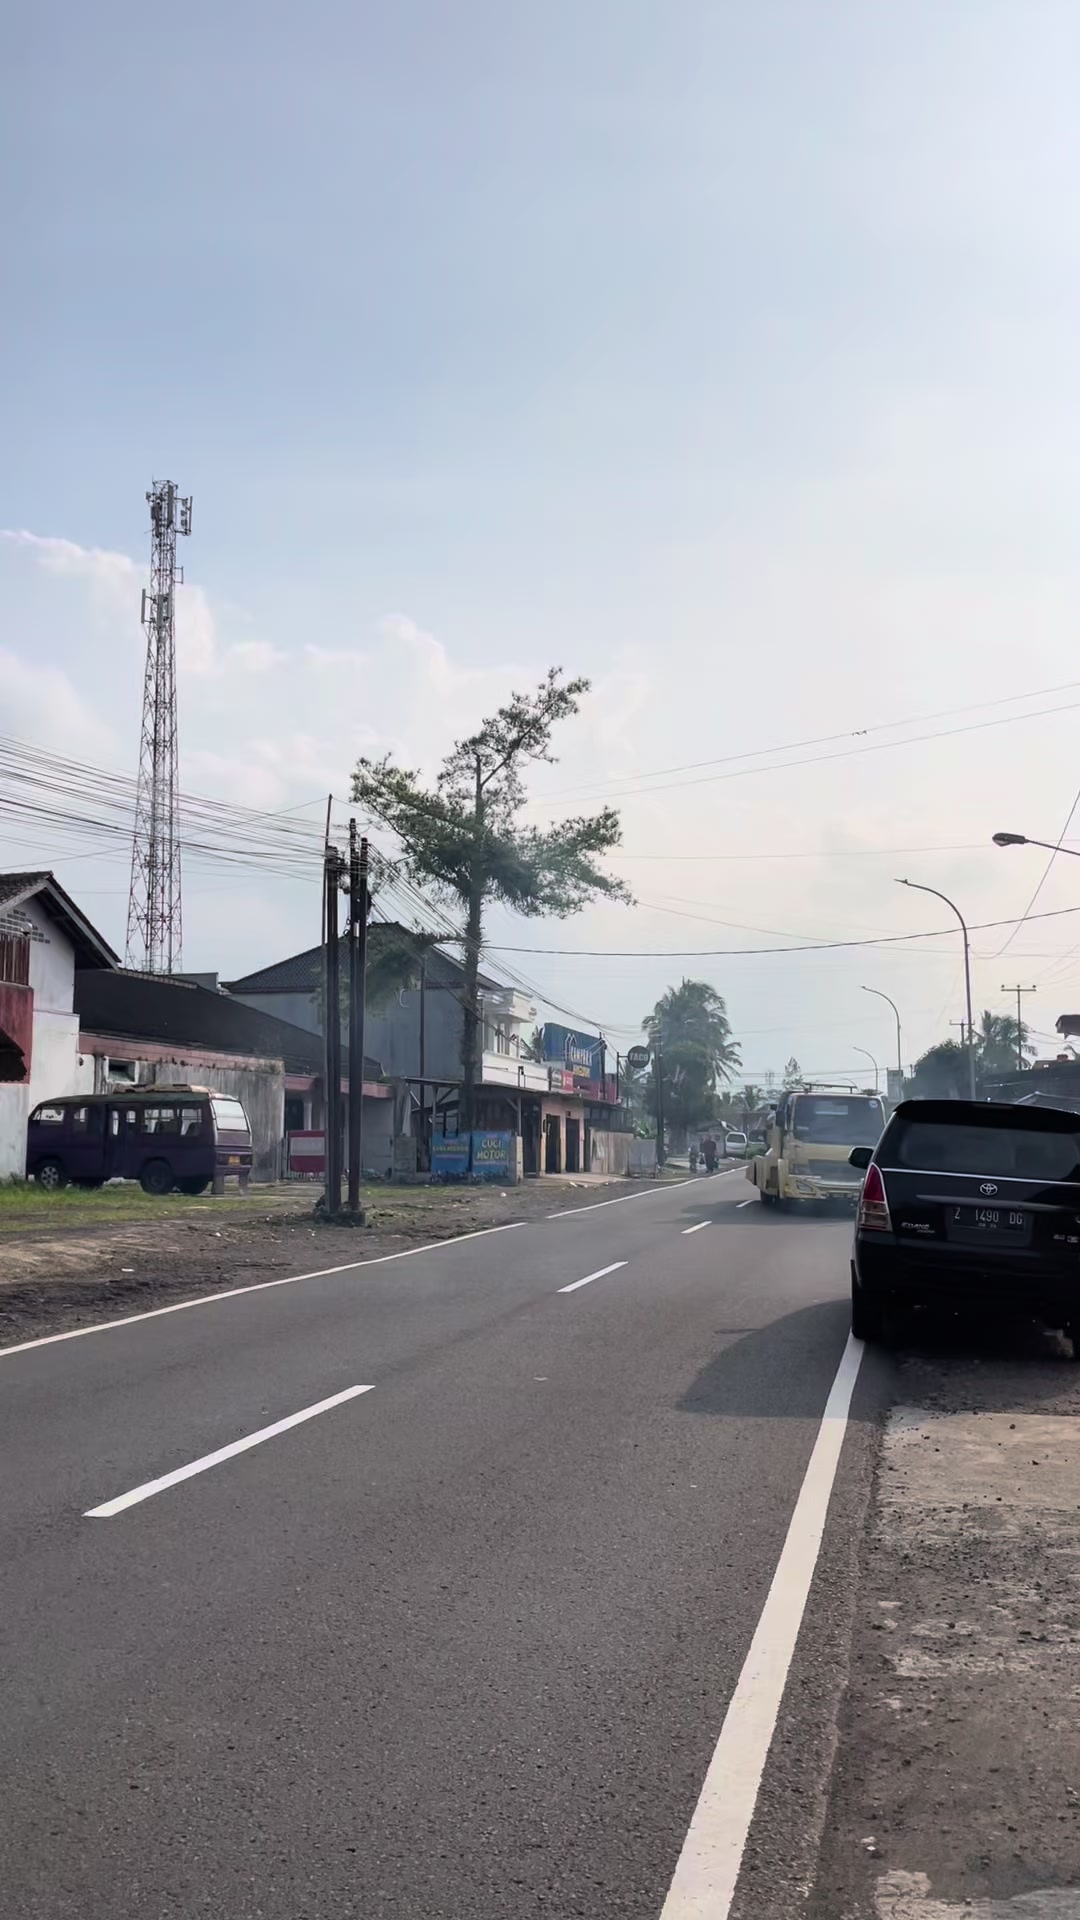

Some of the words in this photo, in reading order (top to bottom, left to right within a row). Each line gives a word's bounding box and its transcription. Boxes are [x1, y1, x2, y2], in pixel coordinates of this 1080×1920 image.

[481, 1139, 502, 1149] CUCI
[476, 1150, 506, 1160] MOTOR
[953, 1207, 961, 1220] Z
[975, 1208, 999, 1223] 1490
